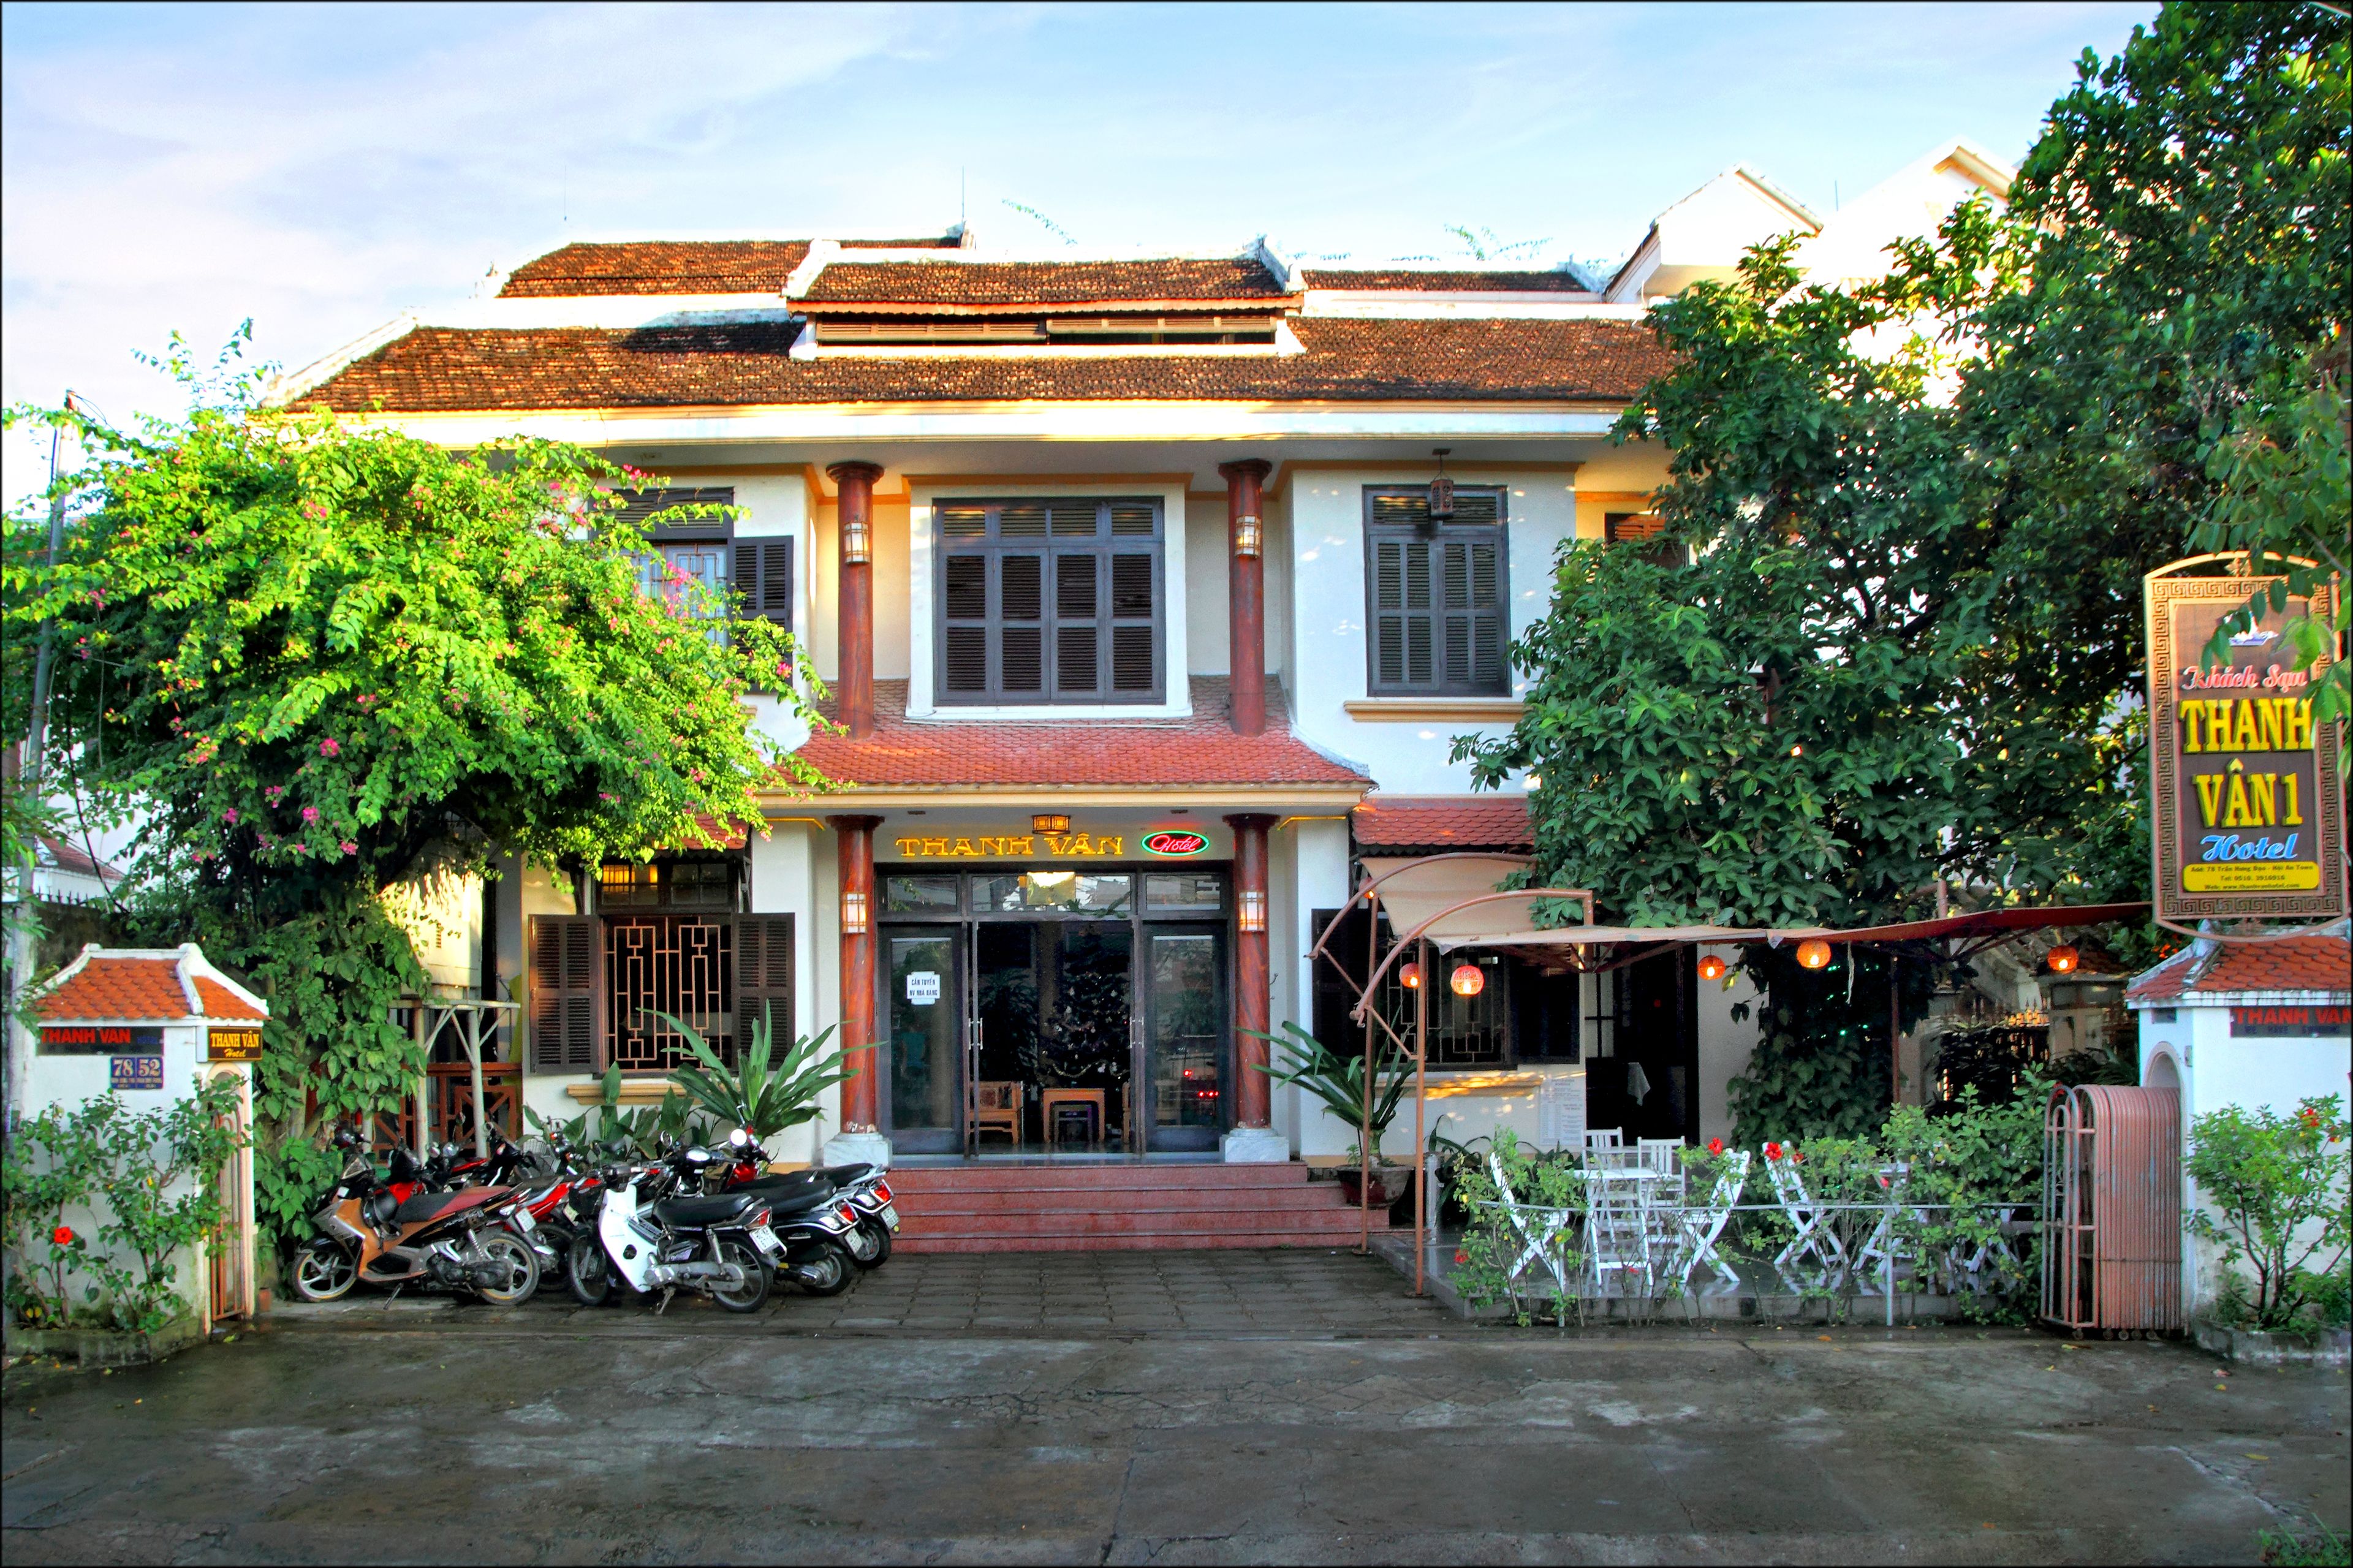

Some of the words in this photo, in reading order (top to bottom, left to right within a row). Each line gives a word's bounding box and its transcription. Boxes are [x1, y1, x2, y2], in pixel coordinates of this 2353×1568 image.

[2181, 664, 2259, 690] Khách
[2179, 697, 2313, 754] THANH
[2192, 757, 2278, 828] VÂN
[2281, 772, 2303, 827] 1
[895, 836, 1034, 857] THANH
[1044, 833, 1123, 855] VÂN
[1151, 835, 1201, 852] Hotel
[2200, 833, 2299, 862] Hotel
[2235, 1007, 2309, 1025] THANH
[41, 1028, 96, 1043] THANH
[211, 1032, 240, 1047] THANH
[113, 1058, 134, 1077] 78
[138, 1058, 161, 1077] 52
